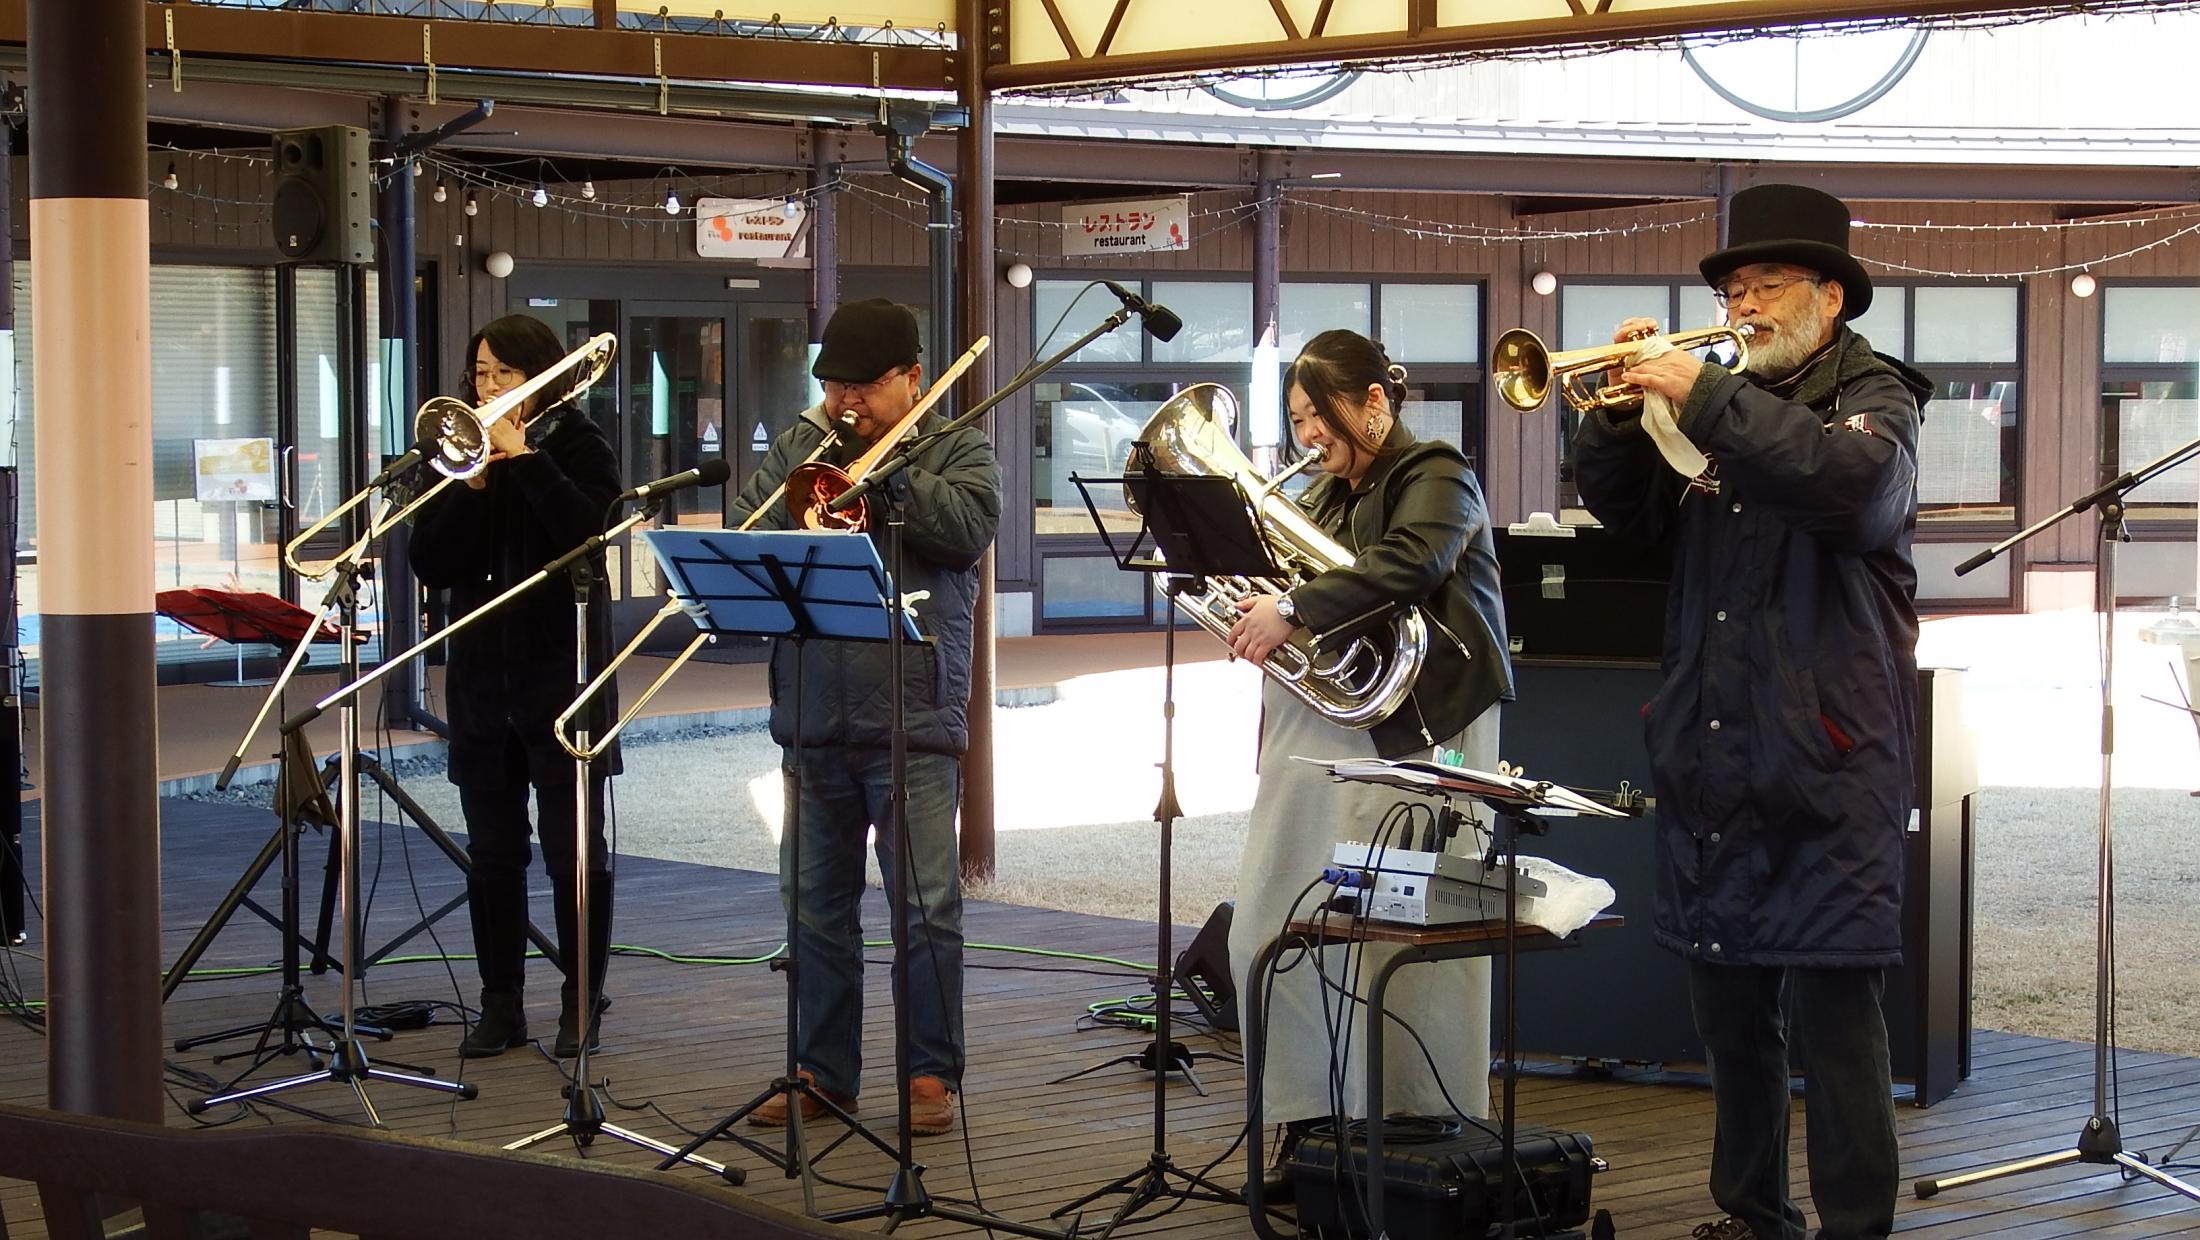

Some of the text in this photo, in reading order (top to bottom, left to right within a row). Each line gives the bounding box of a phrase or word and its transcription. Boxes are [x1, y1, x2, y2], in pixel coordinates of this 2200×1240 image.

[1085, 212, 1156, 233] レストラン
[738, 231, 792, 241] restaurant
[1094, 234, 1146, 248] restaurant
